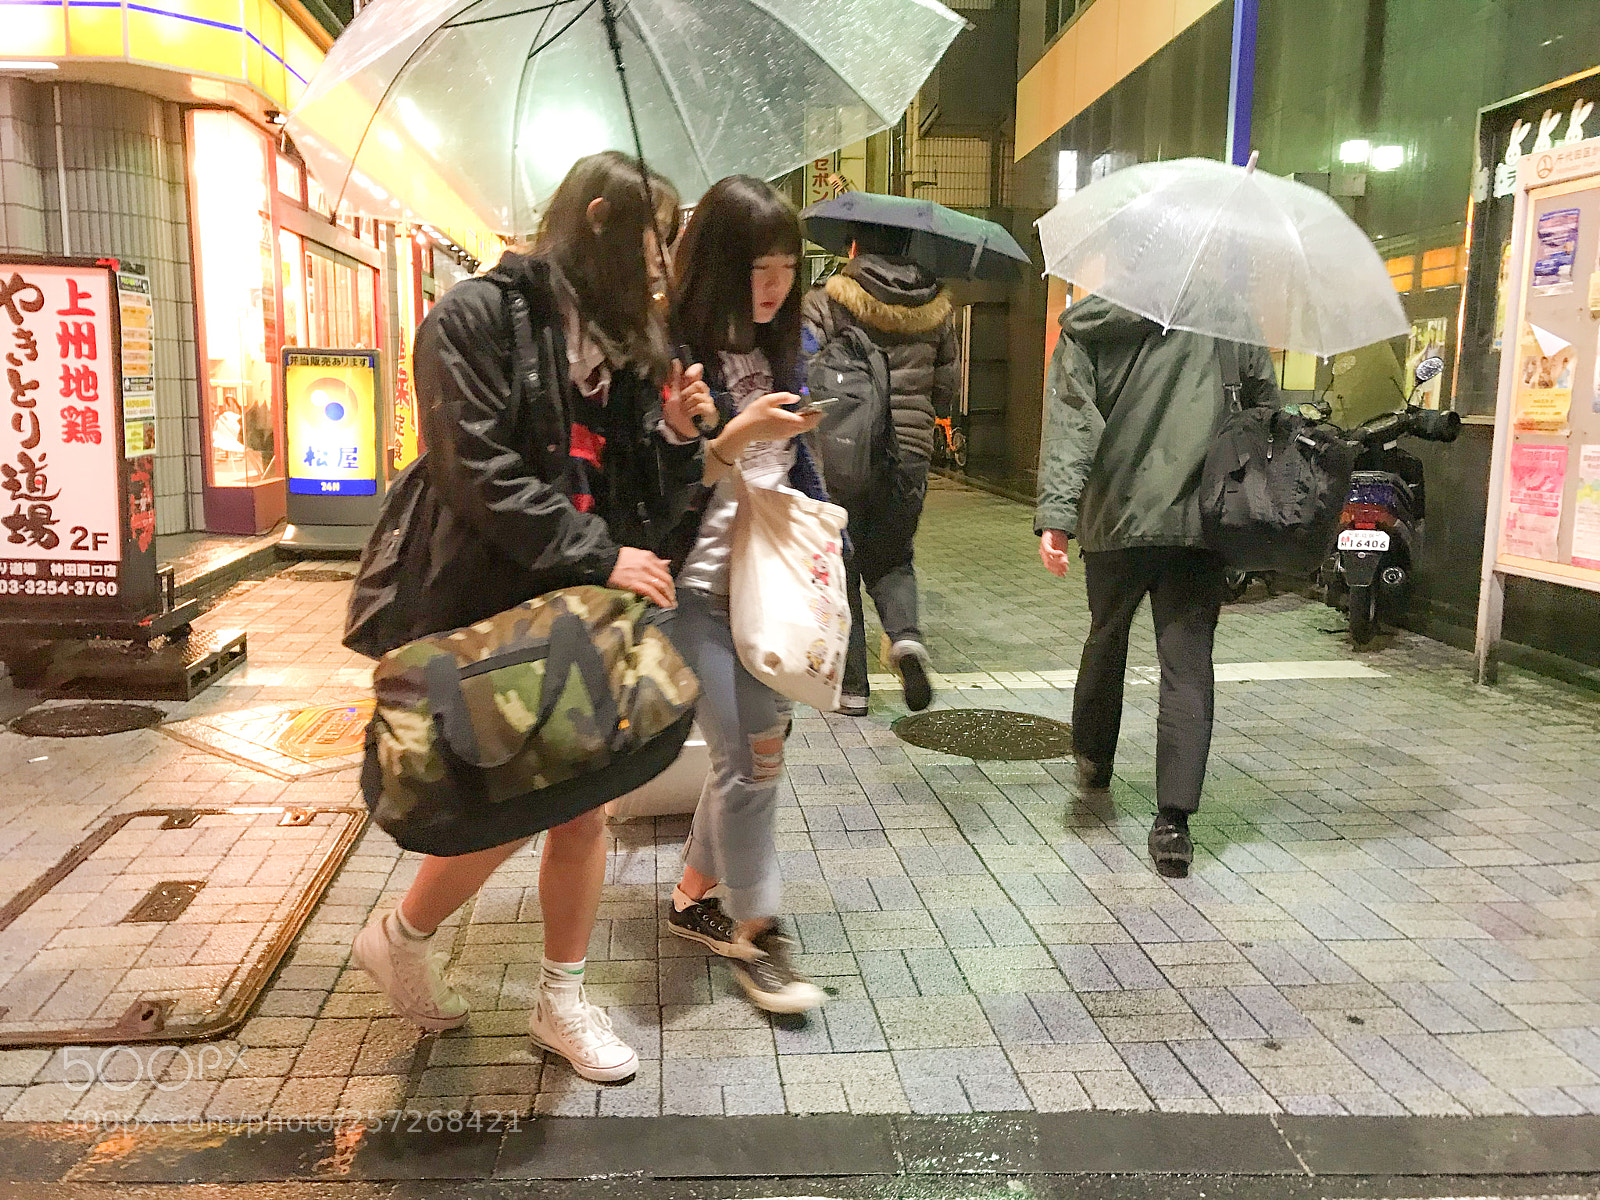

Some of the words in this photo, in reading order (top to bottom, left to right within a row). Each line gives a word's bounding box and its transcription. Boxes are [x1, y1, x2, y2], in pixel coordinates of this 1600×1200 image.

[56, 278, 102, 445] 上州地鶏
[289, 356, 368, 368] 弁当販売あります
[0, 272, 62, 550] やきとり道場
[304, 446, 359, 469] 松屋
[69, 525, 109, 551] 2F
[0, 579, 118, 597] 03-3254-3760
